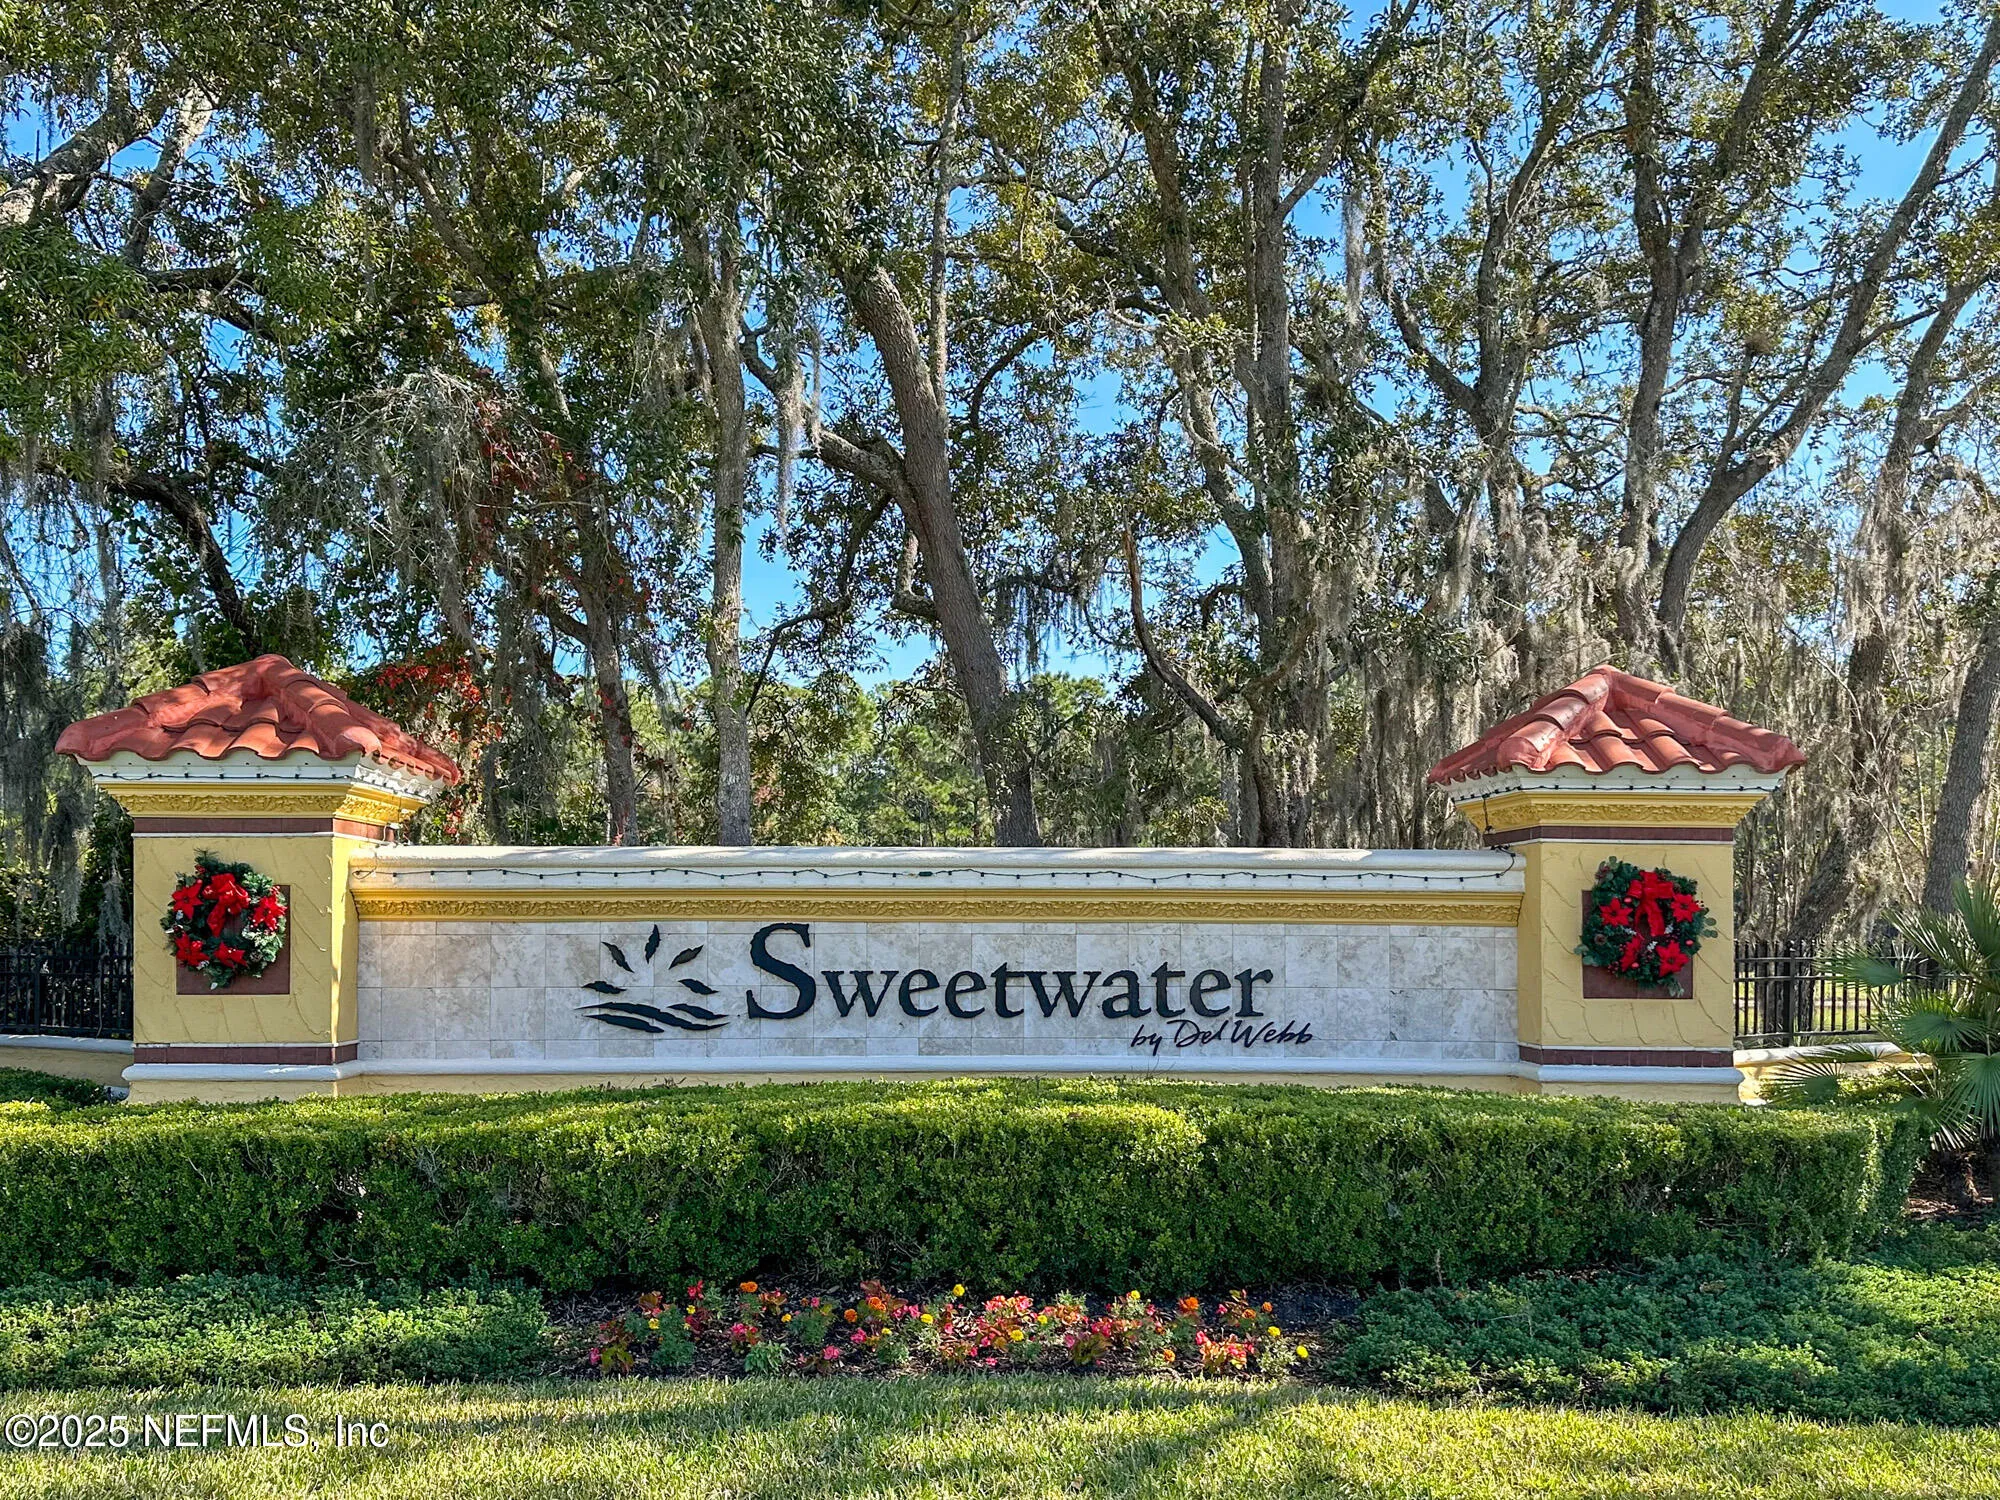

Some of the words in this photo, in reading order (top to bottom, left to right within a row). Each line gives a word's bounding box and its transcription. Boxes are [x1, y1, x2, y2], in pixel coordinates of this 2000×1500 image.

[745, 922, 1273, 1021] Sweetwater
[1131, 1024, 1163, 1056] by
[1167, 1019, 1230, 1048] Del
[1232, 1019, 1314, 1049] Webb
